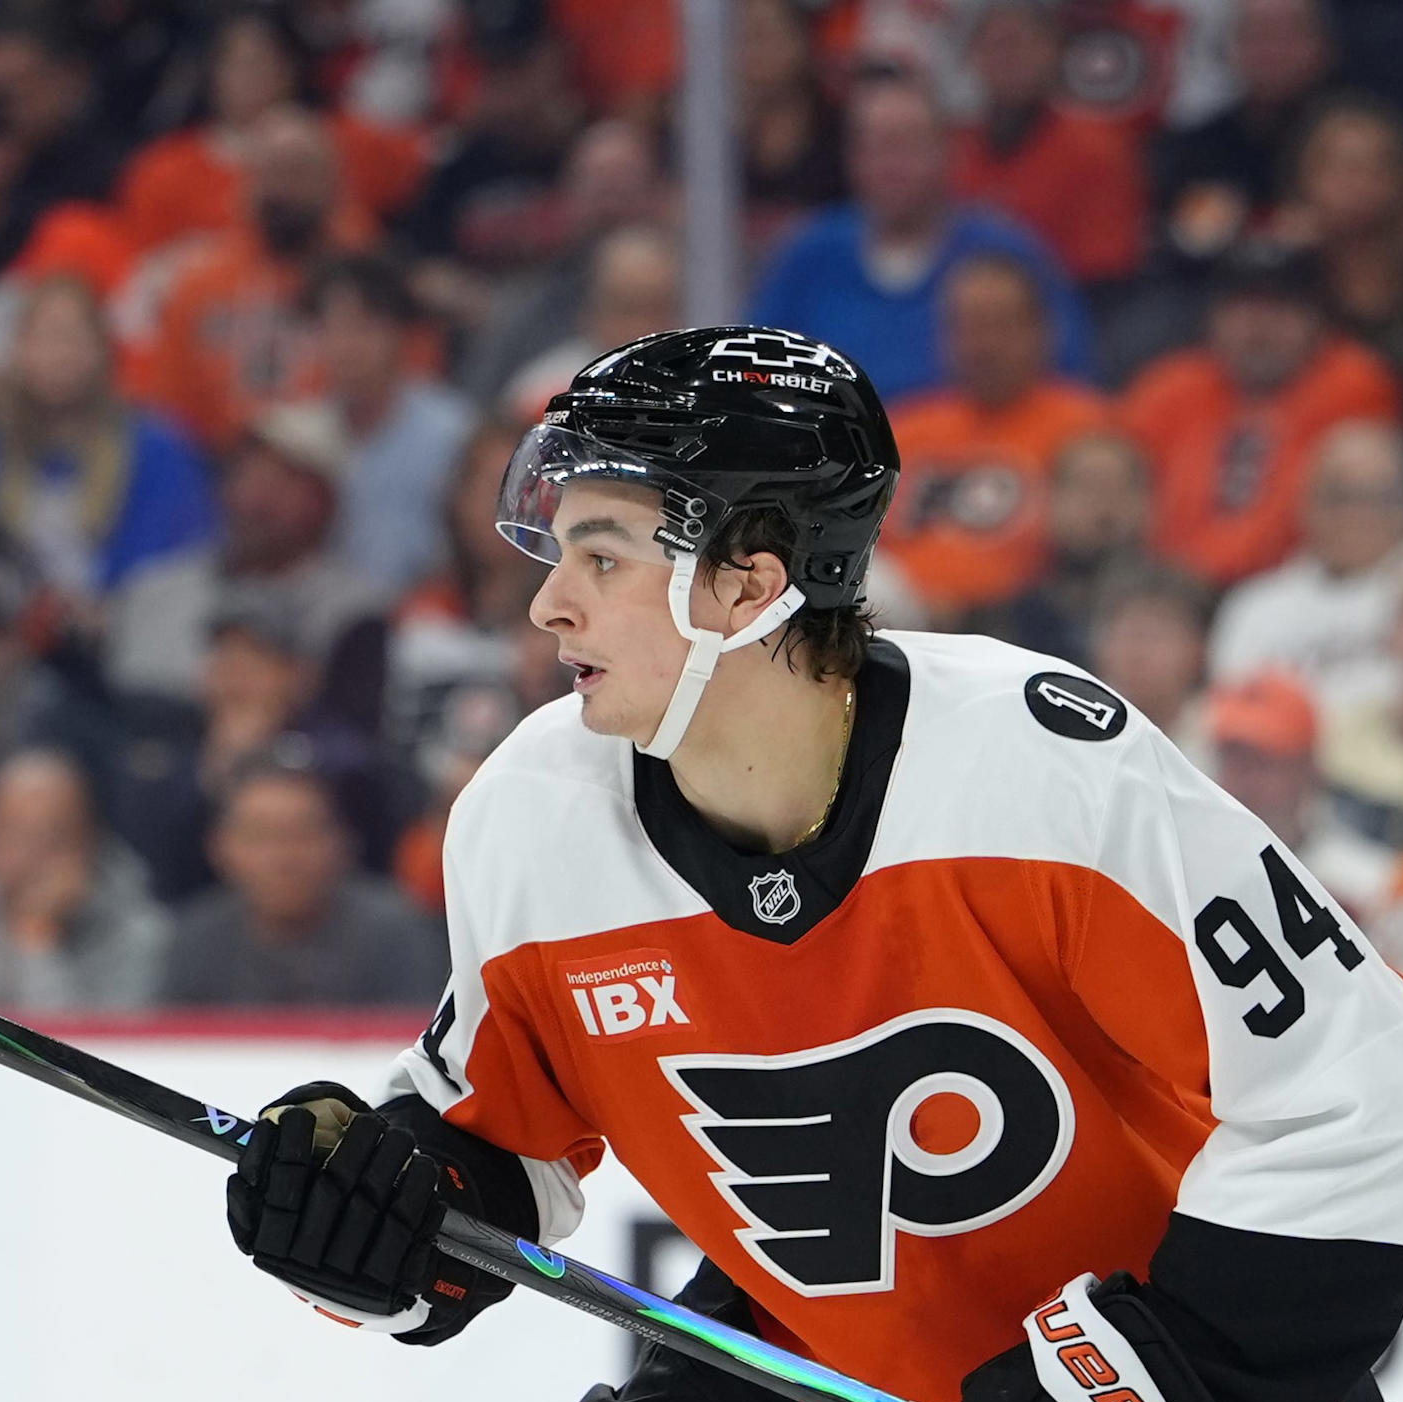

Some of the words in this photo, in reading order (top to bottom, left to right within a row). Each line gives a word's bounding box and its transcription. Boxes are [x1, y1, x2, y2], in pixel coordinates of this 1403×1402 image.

[712, 369, 834, 395] CHEVROLET
[657, 529, 697, 551] BAUER
[764, 883, 788, 915] NHL
[1194, 844, 1366, 1040] 94
[565, 959, 660, 985] Independence
[571, 975, 691, 1036] IBX
